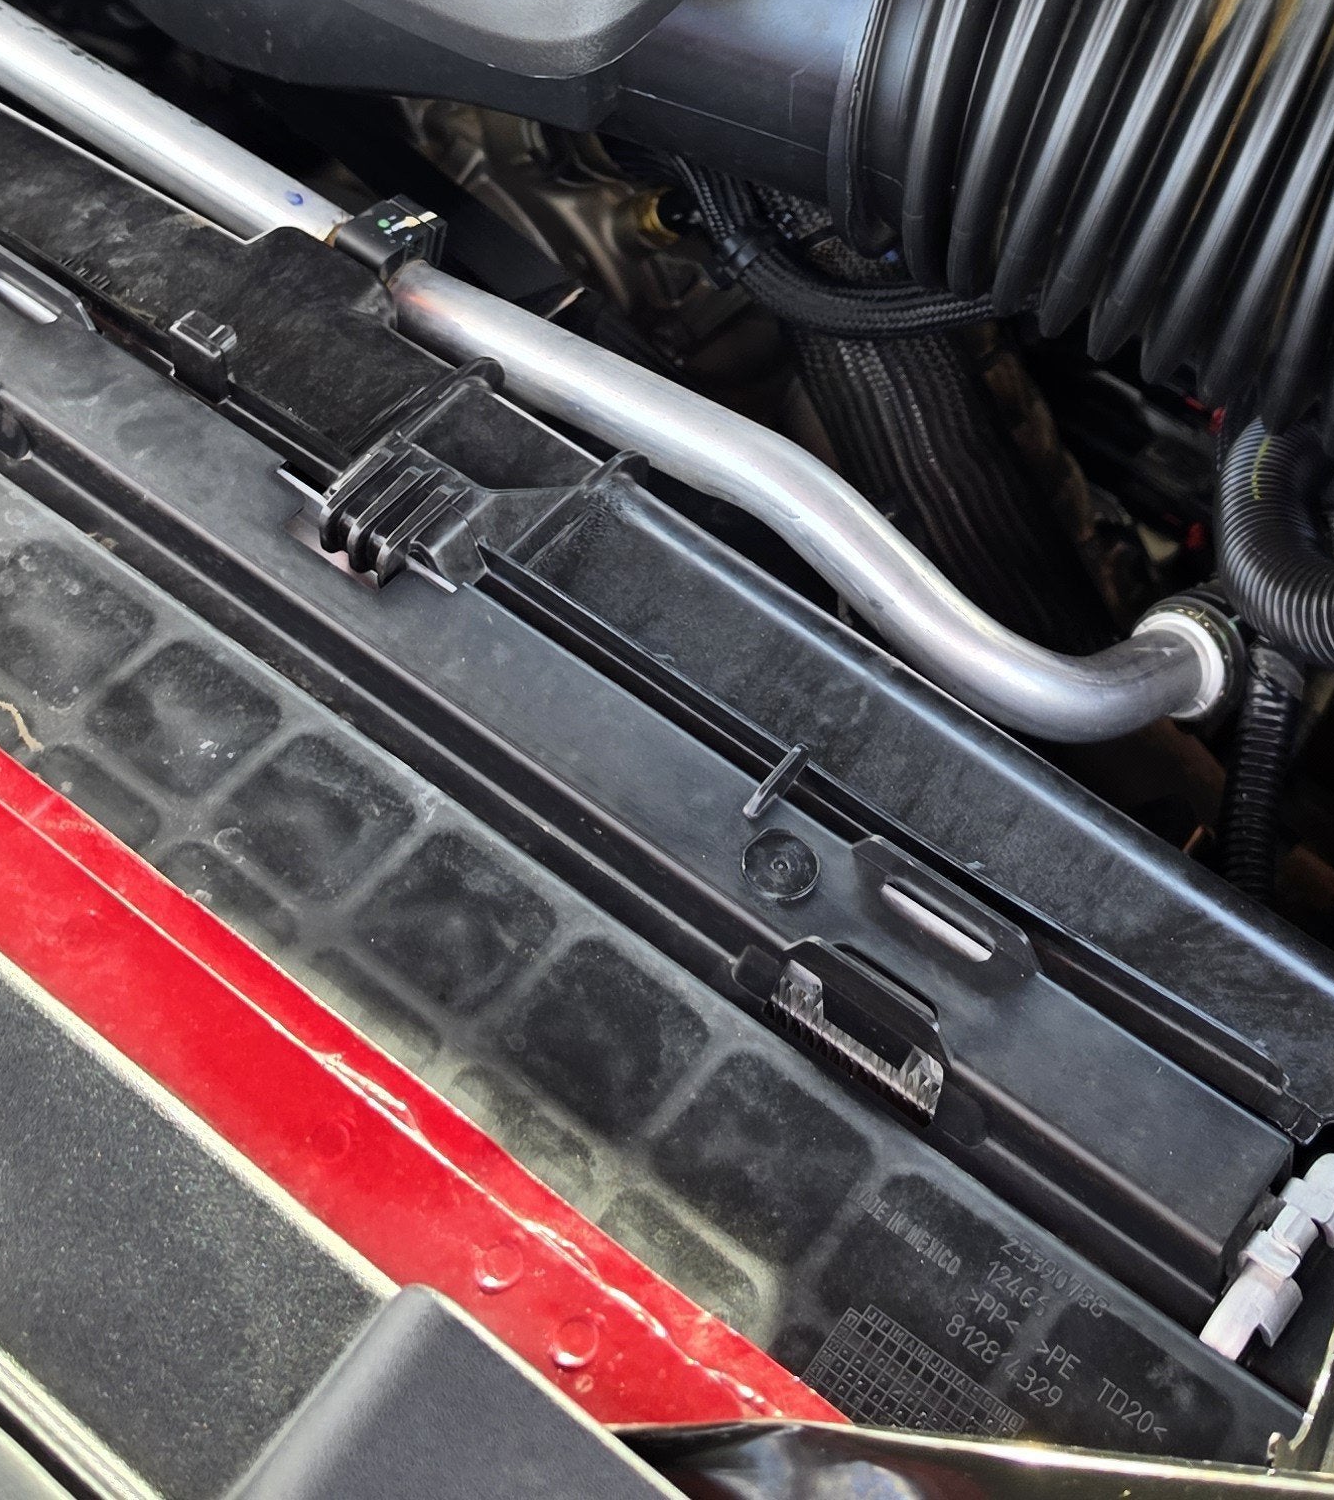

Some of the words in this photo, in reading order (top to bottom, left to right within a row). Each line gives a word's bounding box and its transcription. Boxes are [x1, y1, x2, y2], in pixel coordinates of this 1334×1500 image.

[886, 1210, 909, 1235] IN
[904, 1223, 961, 1275] MEXICO
[1036, 1340, 1082, 1381] >PE
